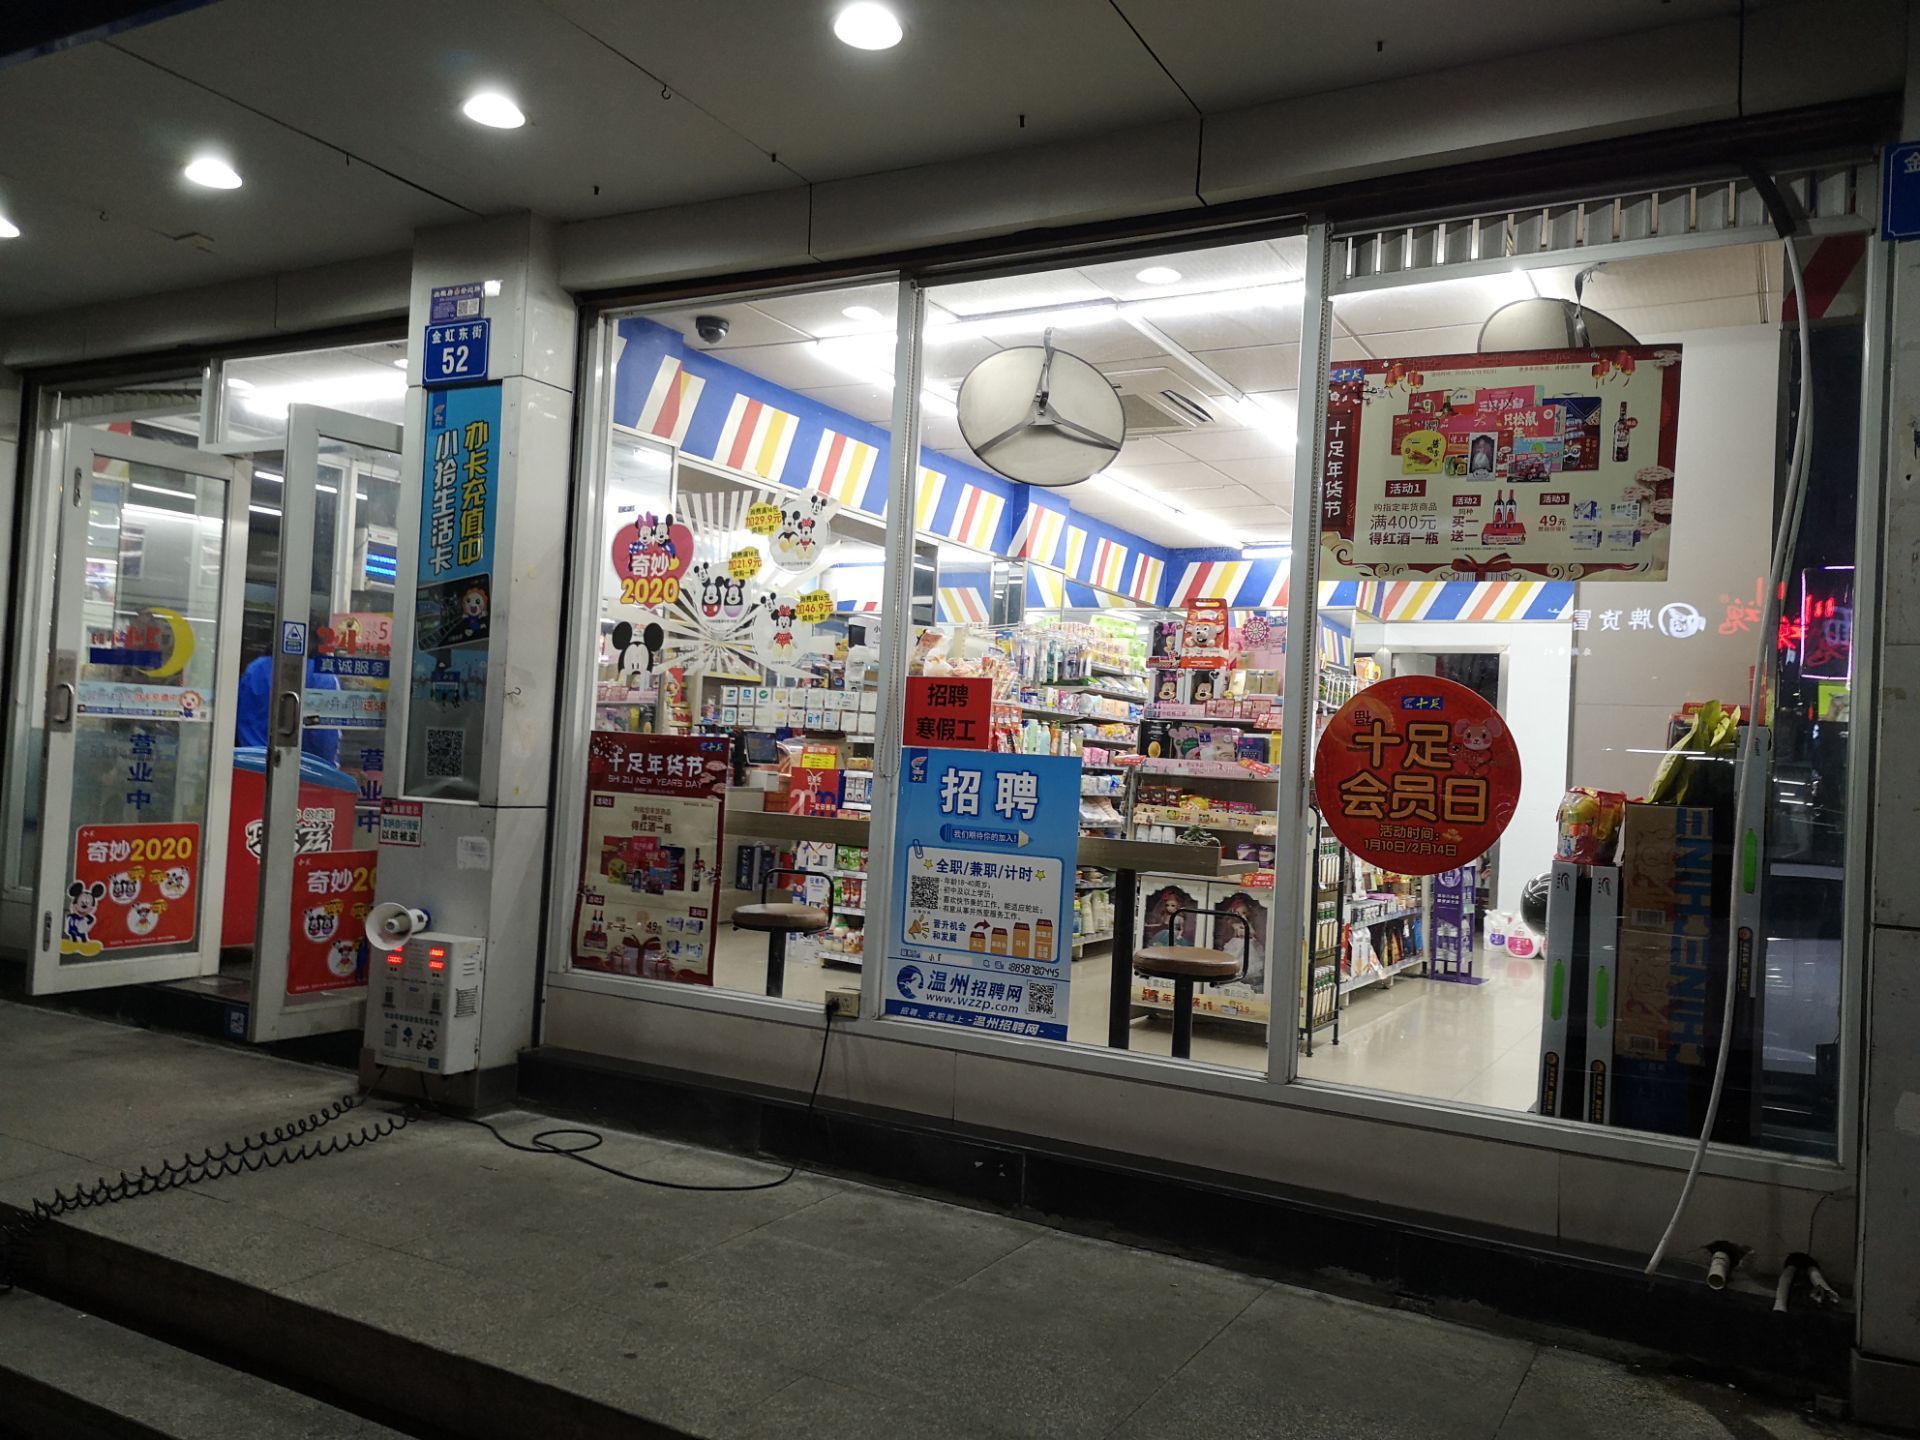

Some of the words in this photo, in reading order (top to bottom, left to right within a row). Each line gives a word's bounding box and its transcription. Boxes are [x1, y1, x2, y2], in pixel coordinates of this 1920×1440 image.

[432, 325, 483, 345] 金虹东街
[442, 345, 469, 375] 52
[1324, 420, 1346, 518] 十足年货节
[458, 420, 488, 567] 办卡充值中
[1389, 482, 1422, 495] 活动1
[428, 428, 459, 576] 小拾生活卡
[1373, 502, 1438, 512] 购指定年货商品
[1455, 496, 1478, 505] 活动2
[1543, 495, 1567, 504] 活动3
[1370, 514, 1437, 531] 满400元
[1452, 515, 1479, 528] 买一
[1539, 514, 1567, 526] 49元
[1368, 531, 1439, 545] 得红酒一瓶
[1451, 530, 1478, 542] 送一
[631, 551, 669, 579] 奇妙
[620, 577, 679, 604] 2020
[795, 601, 834, 614] 加46.9元
[320, 657, 385, 676] 真诚服务
[927, 684, 969, 708] 招聘
[916, 717, 976, 742] 寒假工
[1354, 719, 1452, 769] 十足
[126, 733, 156, 810] 营业中
[608, 751, 705, 778] 十足年货节
[357, 749, 384, 834] 营业中
[636, 777, 653, 786] NEW
[685, 780, 703, 789] DAY
[940, 767, 1038, 820] 招聘
[1340, 772, 1487, 822] 会员日
[1380, 824, 1440, 841] 活动时间：
[87, 836, 193, 863] 奇妙2020
[1364, 840, 1457, 857] 1月10日/2月14日
[936, 858, 1033, 882] 全职/兼职/计时
[933, 919, 967, 932] 晋升机会
[932, 930, 958, 943] 和发展
[927, 969, 1023, 1003] 温州招聘网
[926, 992, 1019, 1013] www.wzzp.com
